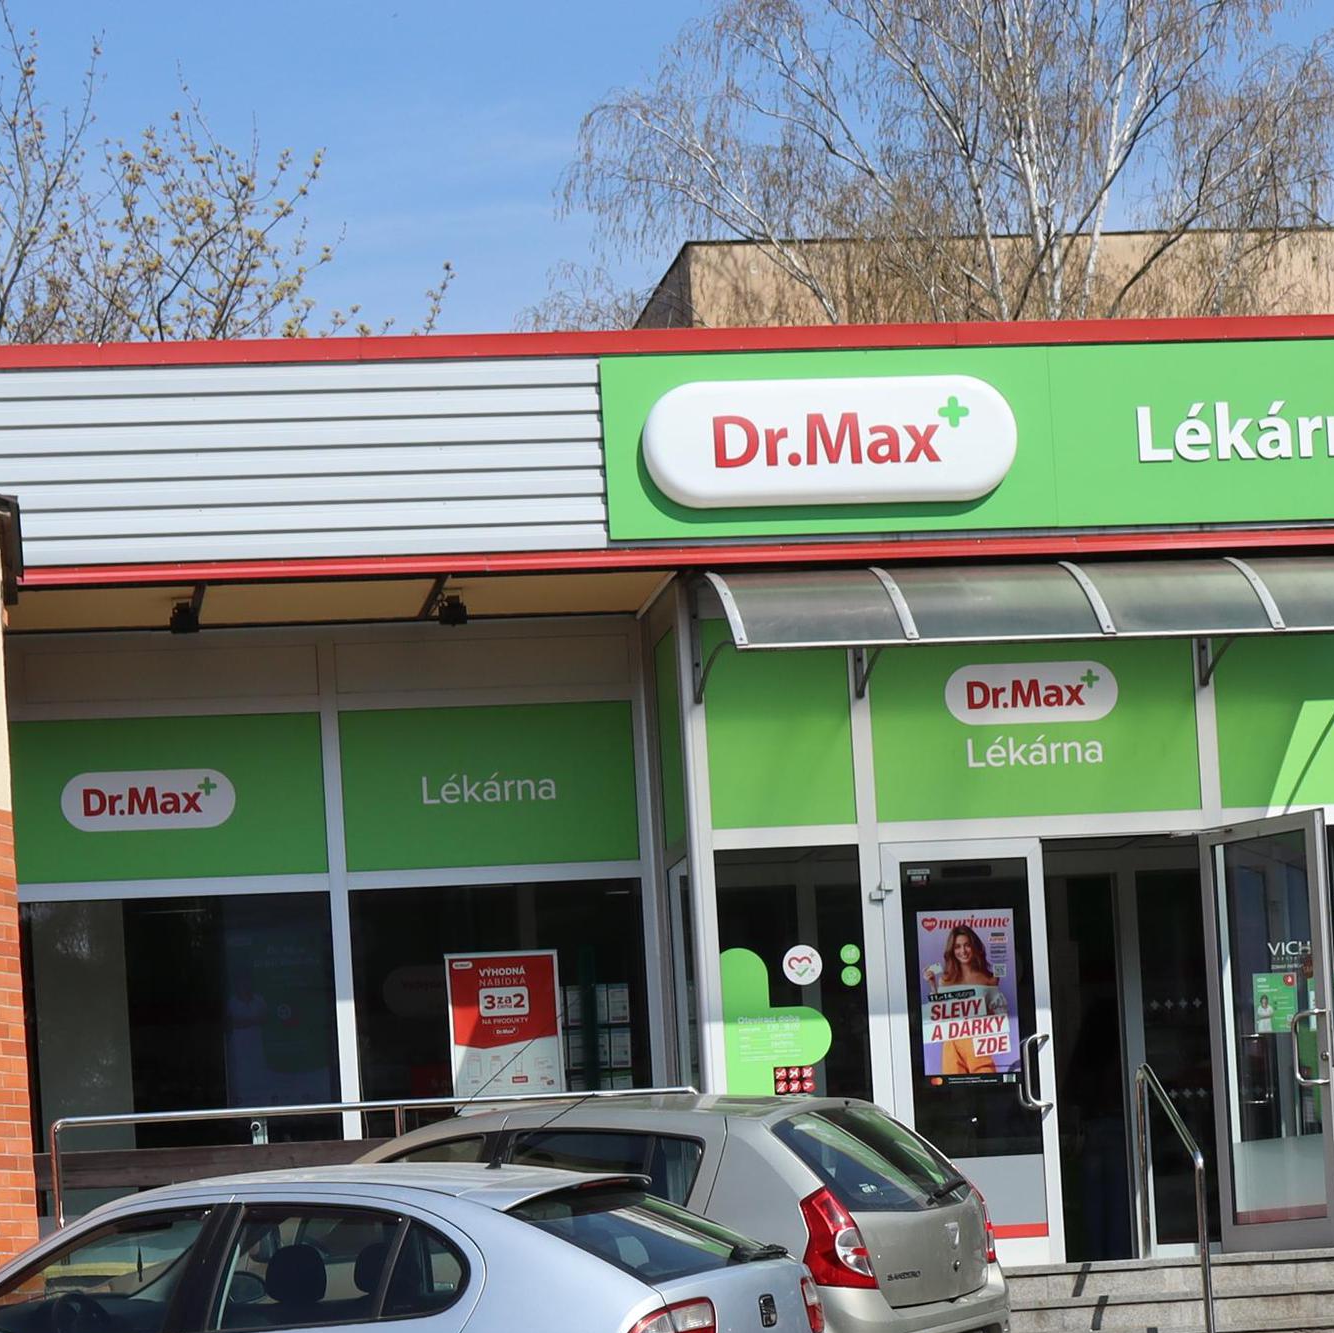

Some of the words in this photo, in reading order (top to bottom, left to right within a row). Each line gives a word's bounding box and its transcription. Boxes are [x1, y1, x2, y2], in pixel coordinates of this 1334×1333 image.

[711, 411, 942, 469] Dr.Max
[965, 678, 1086, 710] Dr.Max
[966, 736, 1104, 769] Lékárna
[82, 786, 203, 817] Dr.Max
[421, 773, 558, 805] Lékárna
[939, 913, 1011, 930] marianne
[479, 966, 526, 978] VÝHODNÁ
[479, 976, 527, 987] NABÍDKA
[483, 994, 496, 1010] 3
[497, 995, 513, 1005] za
[513, 993, 525, 1009] 2
[930, 998, 983, 1022] SLEVY
[931, 1024, 943, 1041] A
[948, 1015, 1006, 1039] DÁRKY
[976, 1035, 1009, 1056] ZDE
